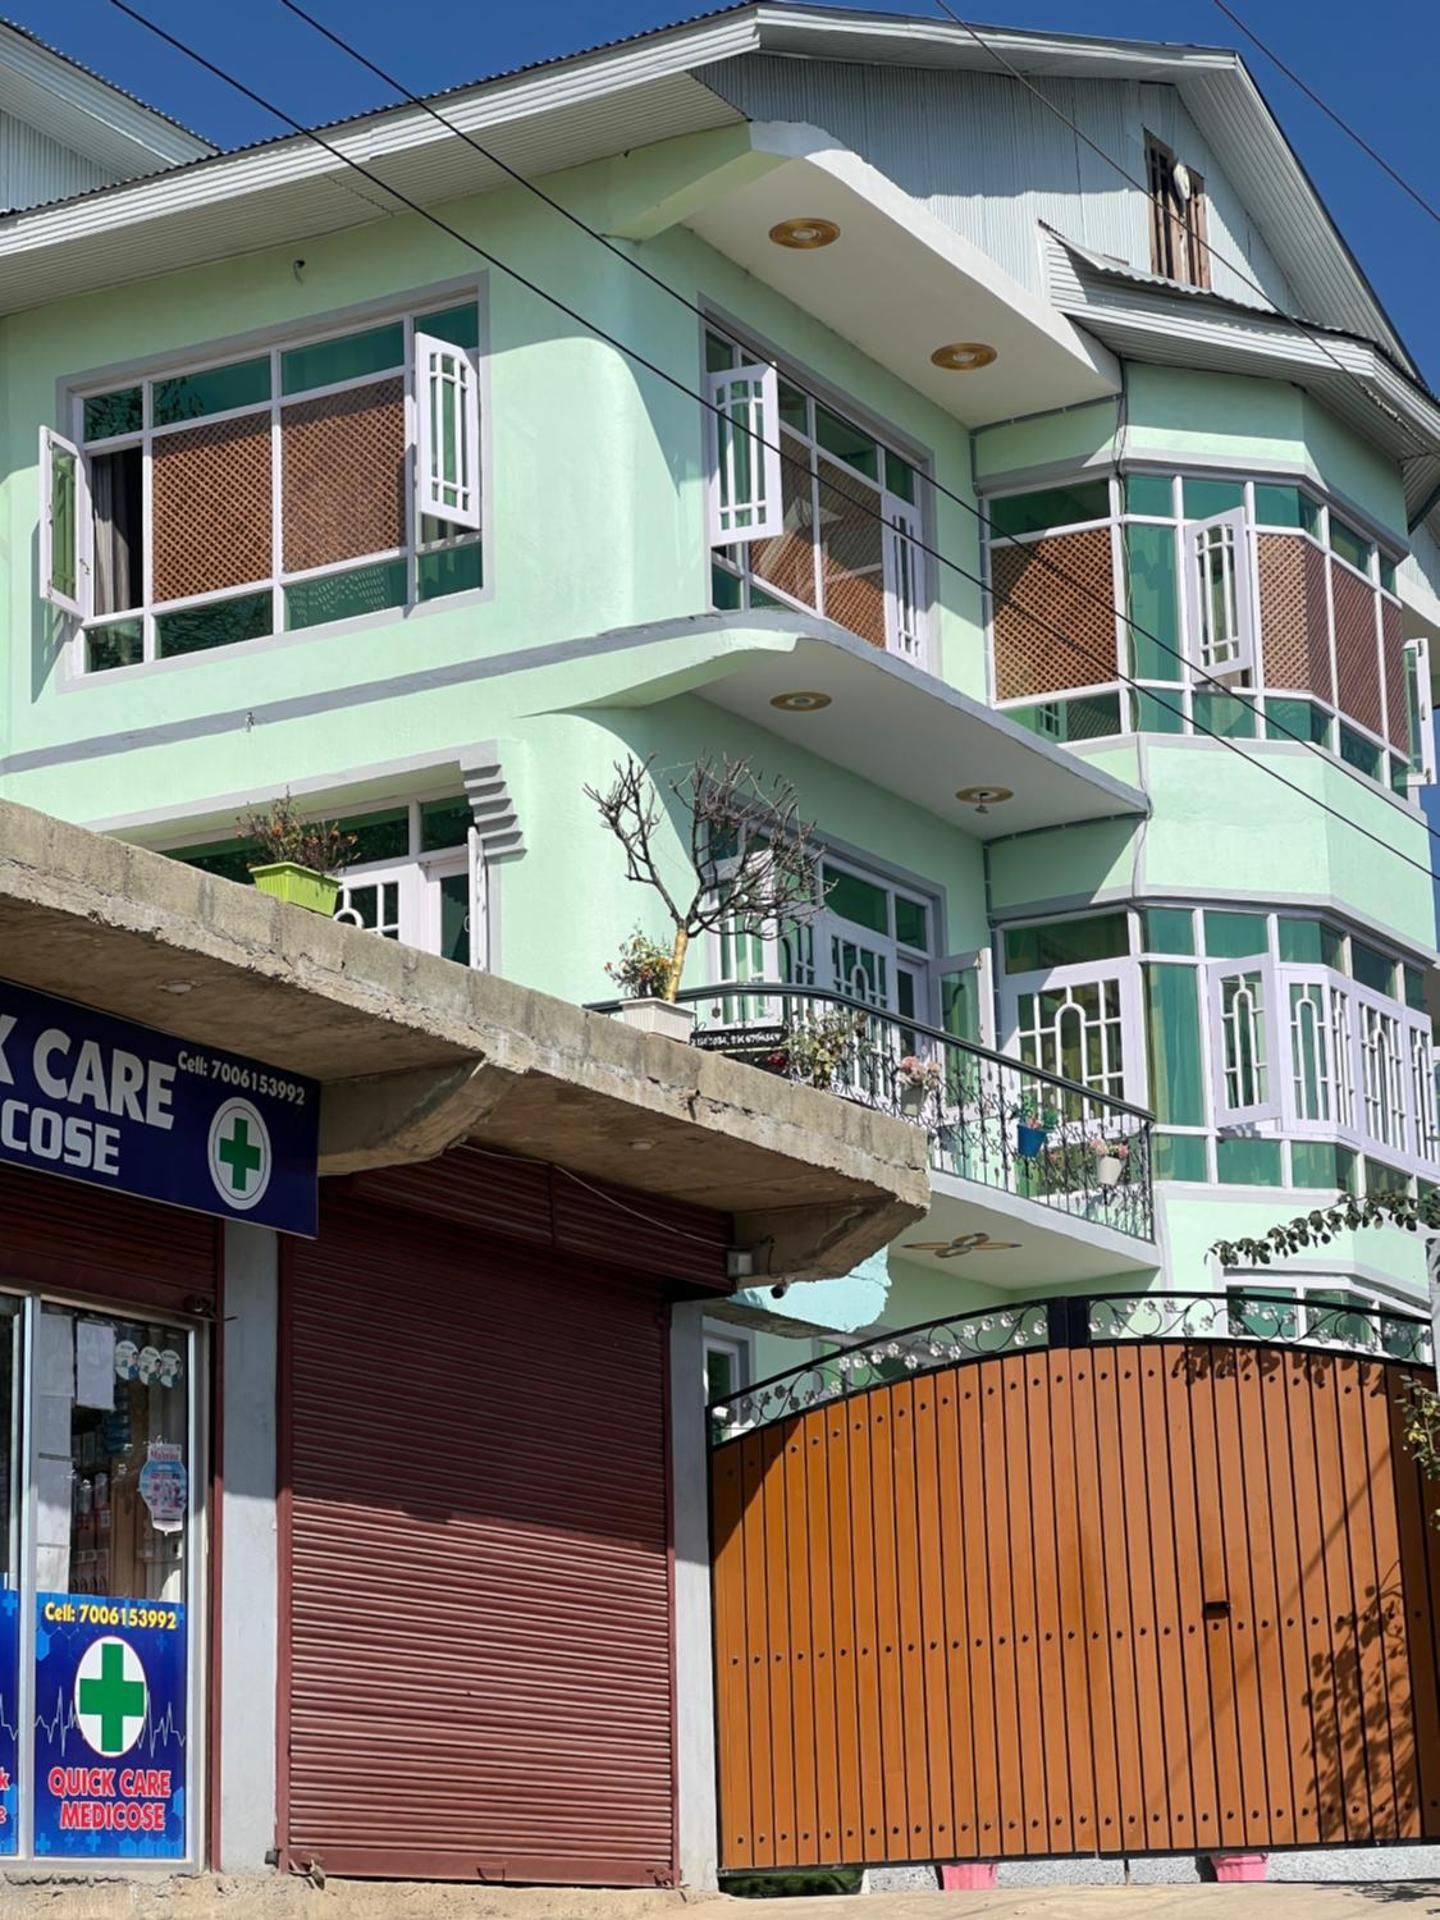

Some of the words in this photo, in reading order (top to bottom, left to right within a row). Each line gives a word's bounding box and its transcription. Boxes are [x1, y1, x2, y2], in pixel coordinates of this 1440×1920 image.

[33, 1028, 177, 1130] CARE
[178, 1051, 208, 1076] Cell:
[211, 1060, 305, 1105] 7006153992
[0, 1099, 121, 1175] COSE
[45, 1602, 76, 1622] Cell:
[79, 1604, 177, 1630] 7006153992
[48, 1767, 116, 1799] QUICK
[119, 1770, 171, 1798] CARE
[59, 1801, 166, 1831] MEDICOSE
